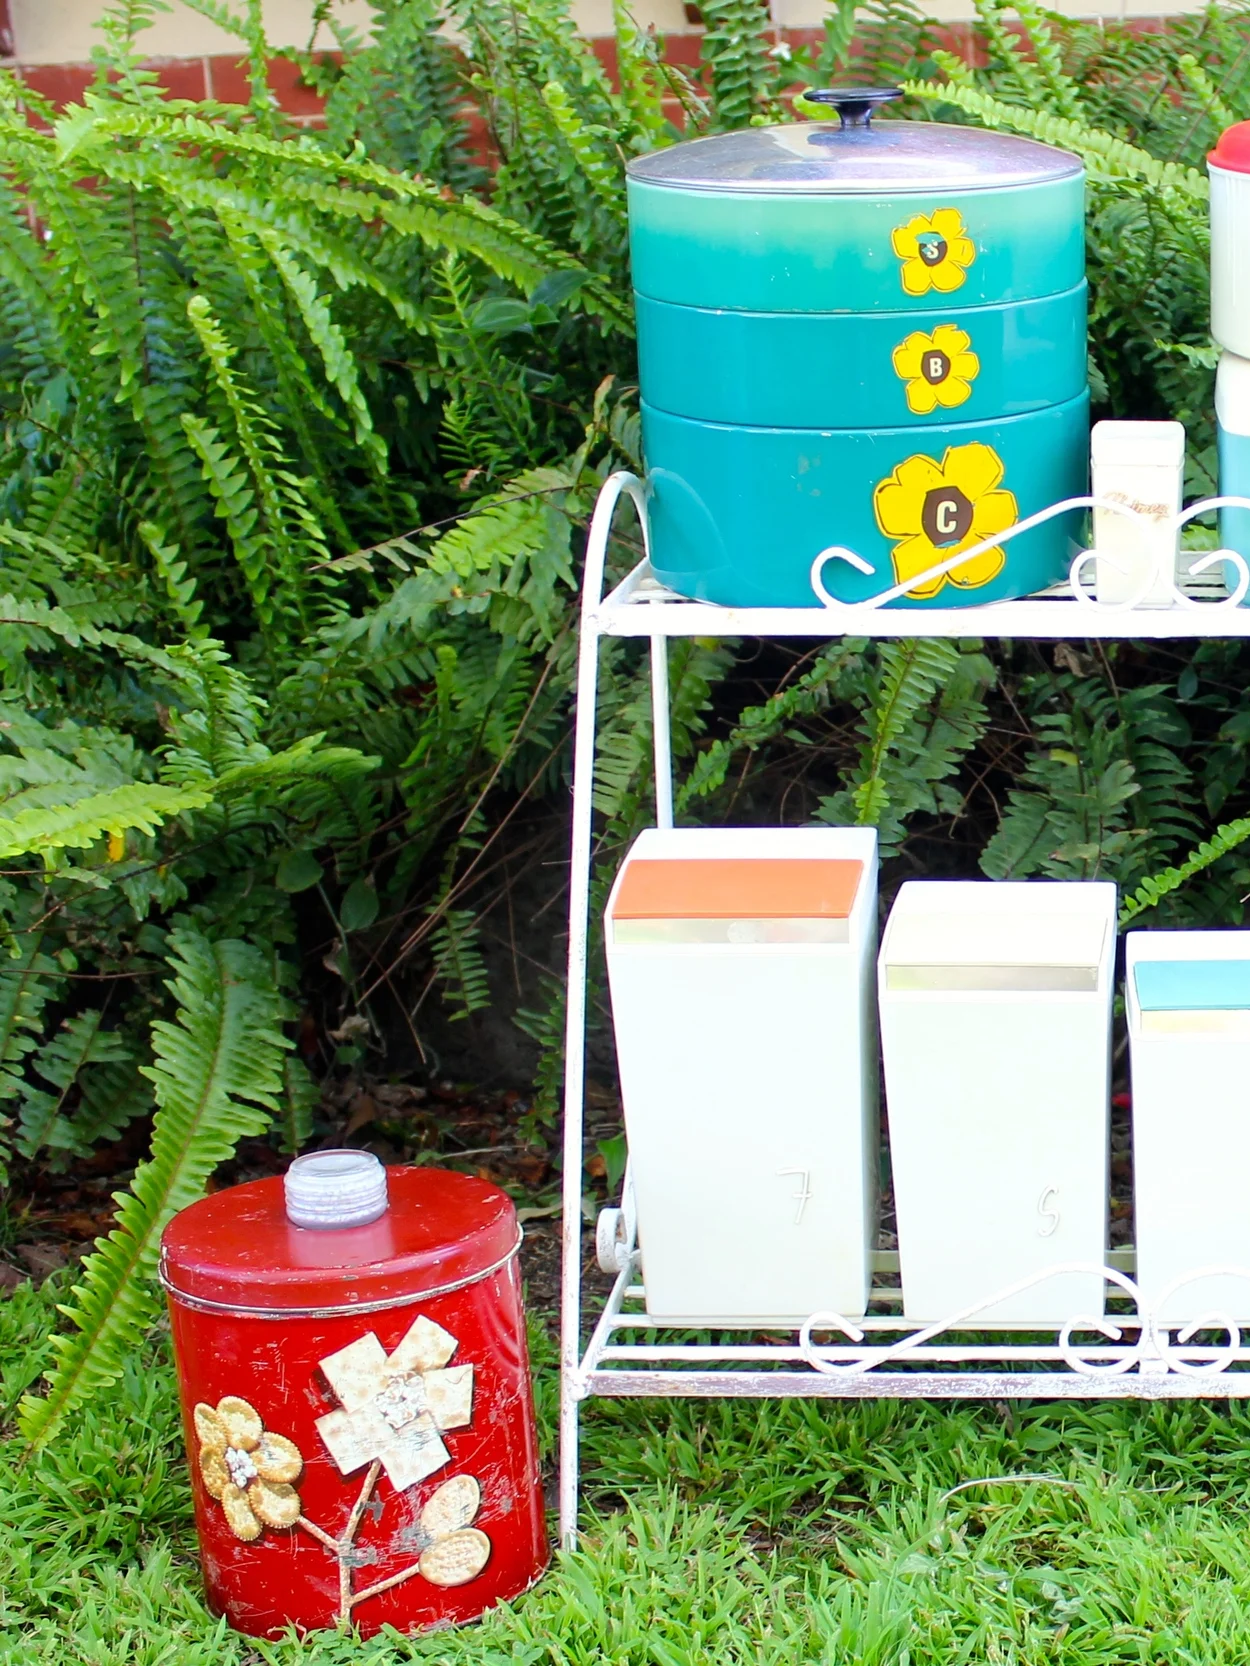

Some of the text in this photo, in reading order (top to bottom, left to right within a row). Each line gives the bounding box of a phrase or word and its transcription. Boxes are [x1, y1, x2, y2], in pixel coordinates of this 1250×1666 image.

[925, 239, 939, 259] S
[929, 357, 943, 378] B
[936, 500, 957, 534] C
[1037, 1184, 1061, 1237] S
